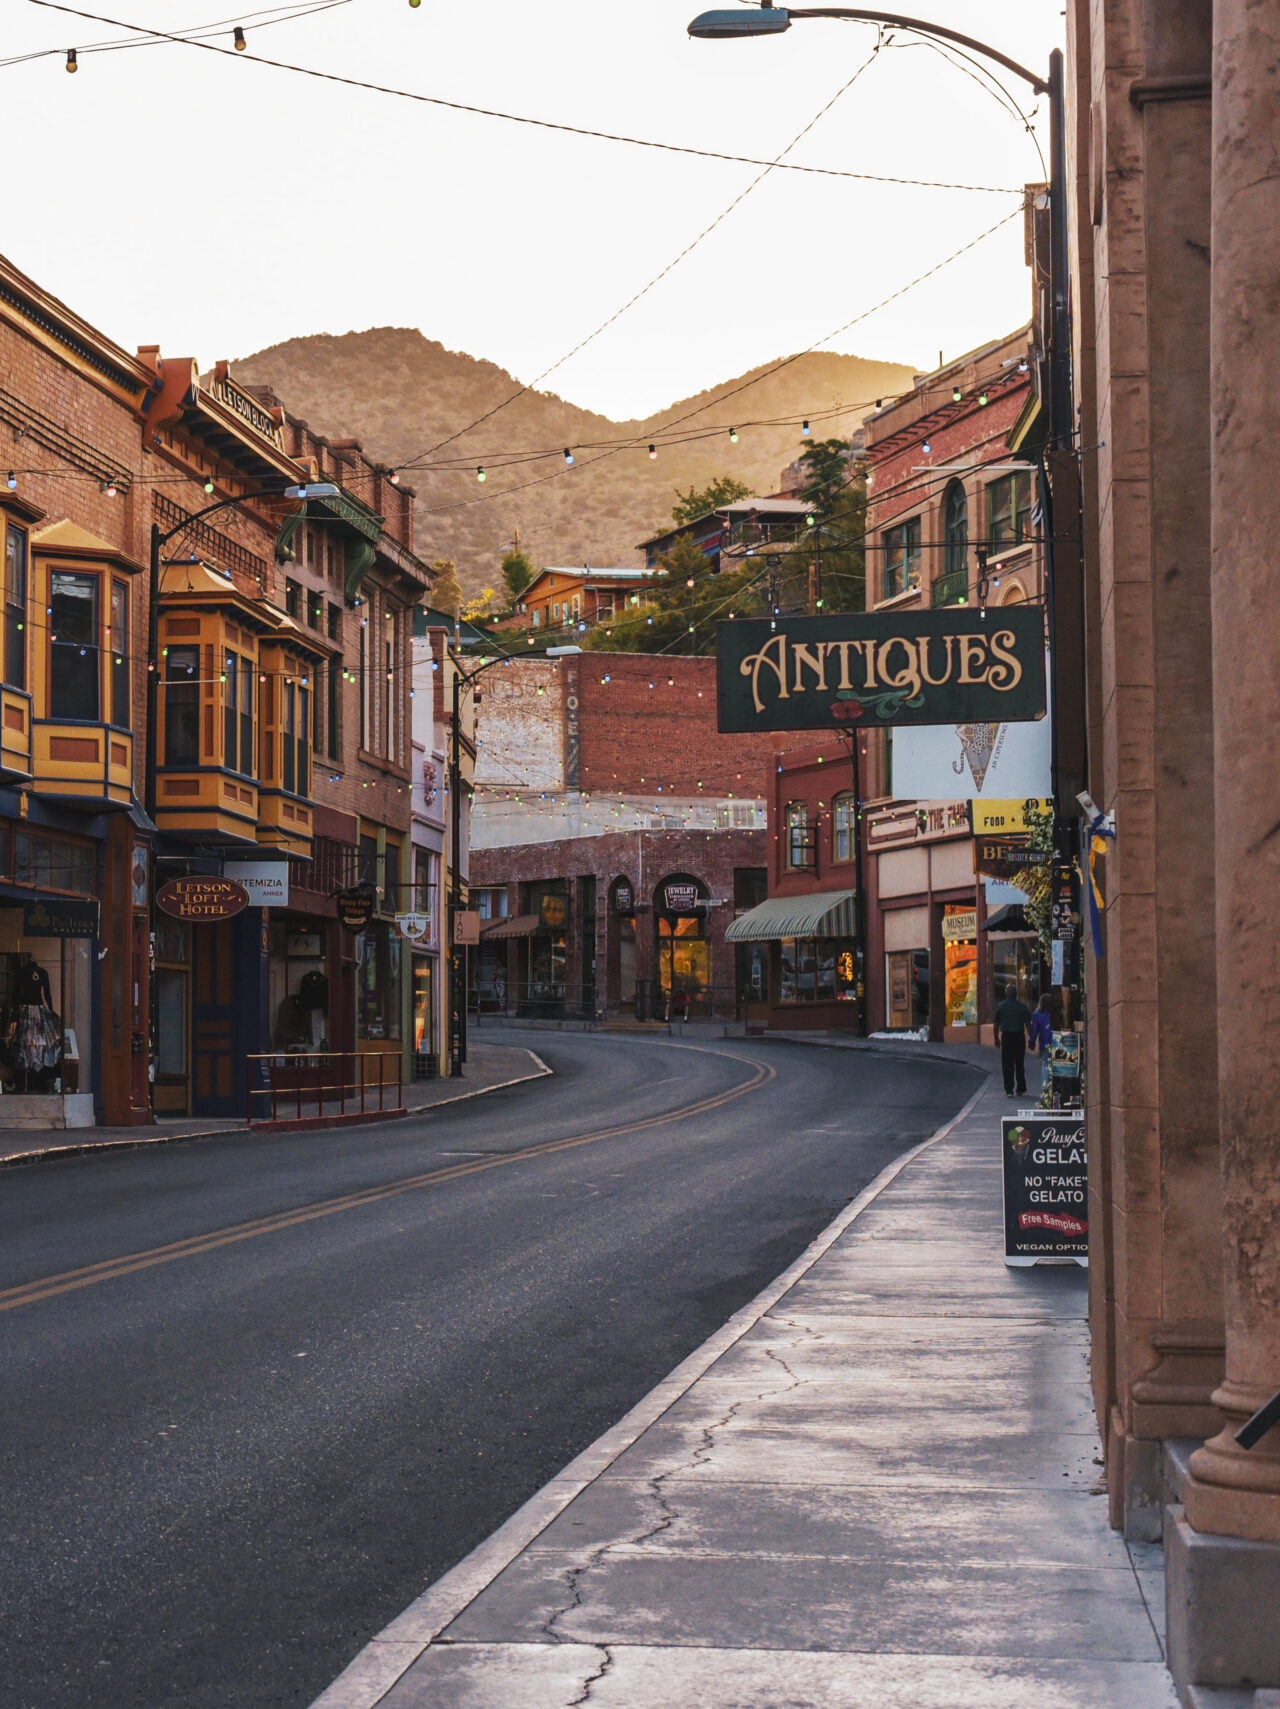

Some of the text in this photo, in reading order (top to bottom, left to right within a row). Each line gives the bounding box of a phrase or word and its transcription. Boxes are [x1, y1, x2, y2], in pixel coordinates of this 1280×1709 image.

[222, 382, 251, 420] LETSON
[740, 630, 1022, 714] ANTIQUES
[928, 807, 945, 831] THE
[984, 816, 1005, 827] FOOD
[176, 882, 231, 894] LETSON
[236, 879, 283, 887] RTEMIZIA
[668, 886, 694, 895] JEWELRY
[185, 893, 220, 904] LOFT
[179, 904, 228, 916] HOTEL
[946, 914, 975, 930] MUSEUM
[1024, 1175, 1088, 1187] NO "FAKE"
[1029, 1190, 1084, 1203] GELATO
[1021, 1213, 1082, 1231] Free Samples
[1016, 1243, 1053, 1251] VEGAN
